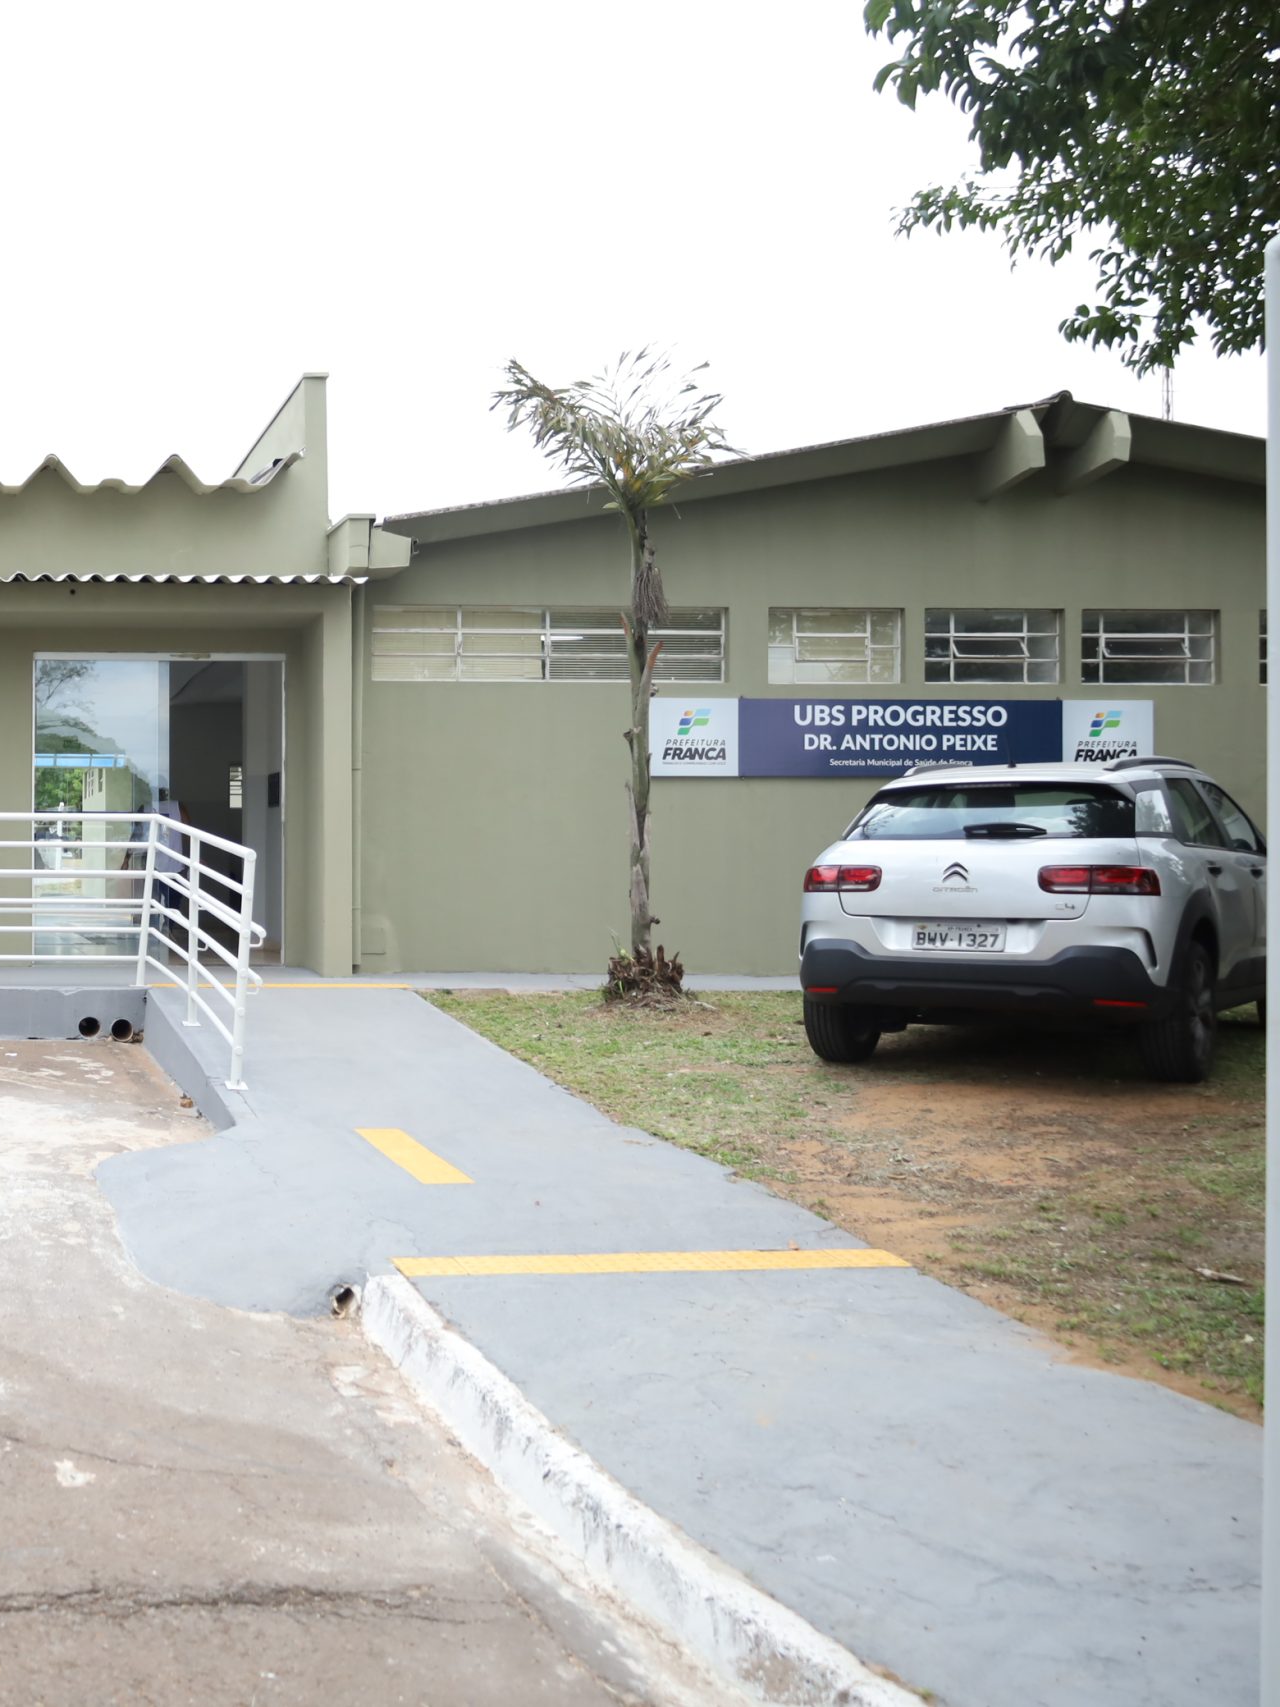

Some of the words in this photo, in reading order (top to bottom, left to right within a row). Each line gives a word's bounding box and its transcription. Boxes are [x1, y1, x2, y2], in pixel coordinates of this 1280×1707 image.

[793, 704, 846, 727] UBS
[851, 704, 1008, 727] PROGRESSO
[665, 739, 726, 747] PREFEITURA
[804, 733, 837, 751] DR.
[840, 733, 938, 751] ANTONIO
[942, 734, 998, 751] PEIXE
[1077, 740, 1137, 748] PREFEITURA
[662, 747, 727, 761] FRANCA
[829, 758, 866, 767] Secretaria
[867, 758, 902, 768] Municipal
[903, 758, 913, 767] de
